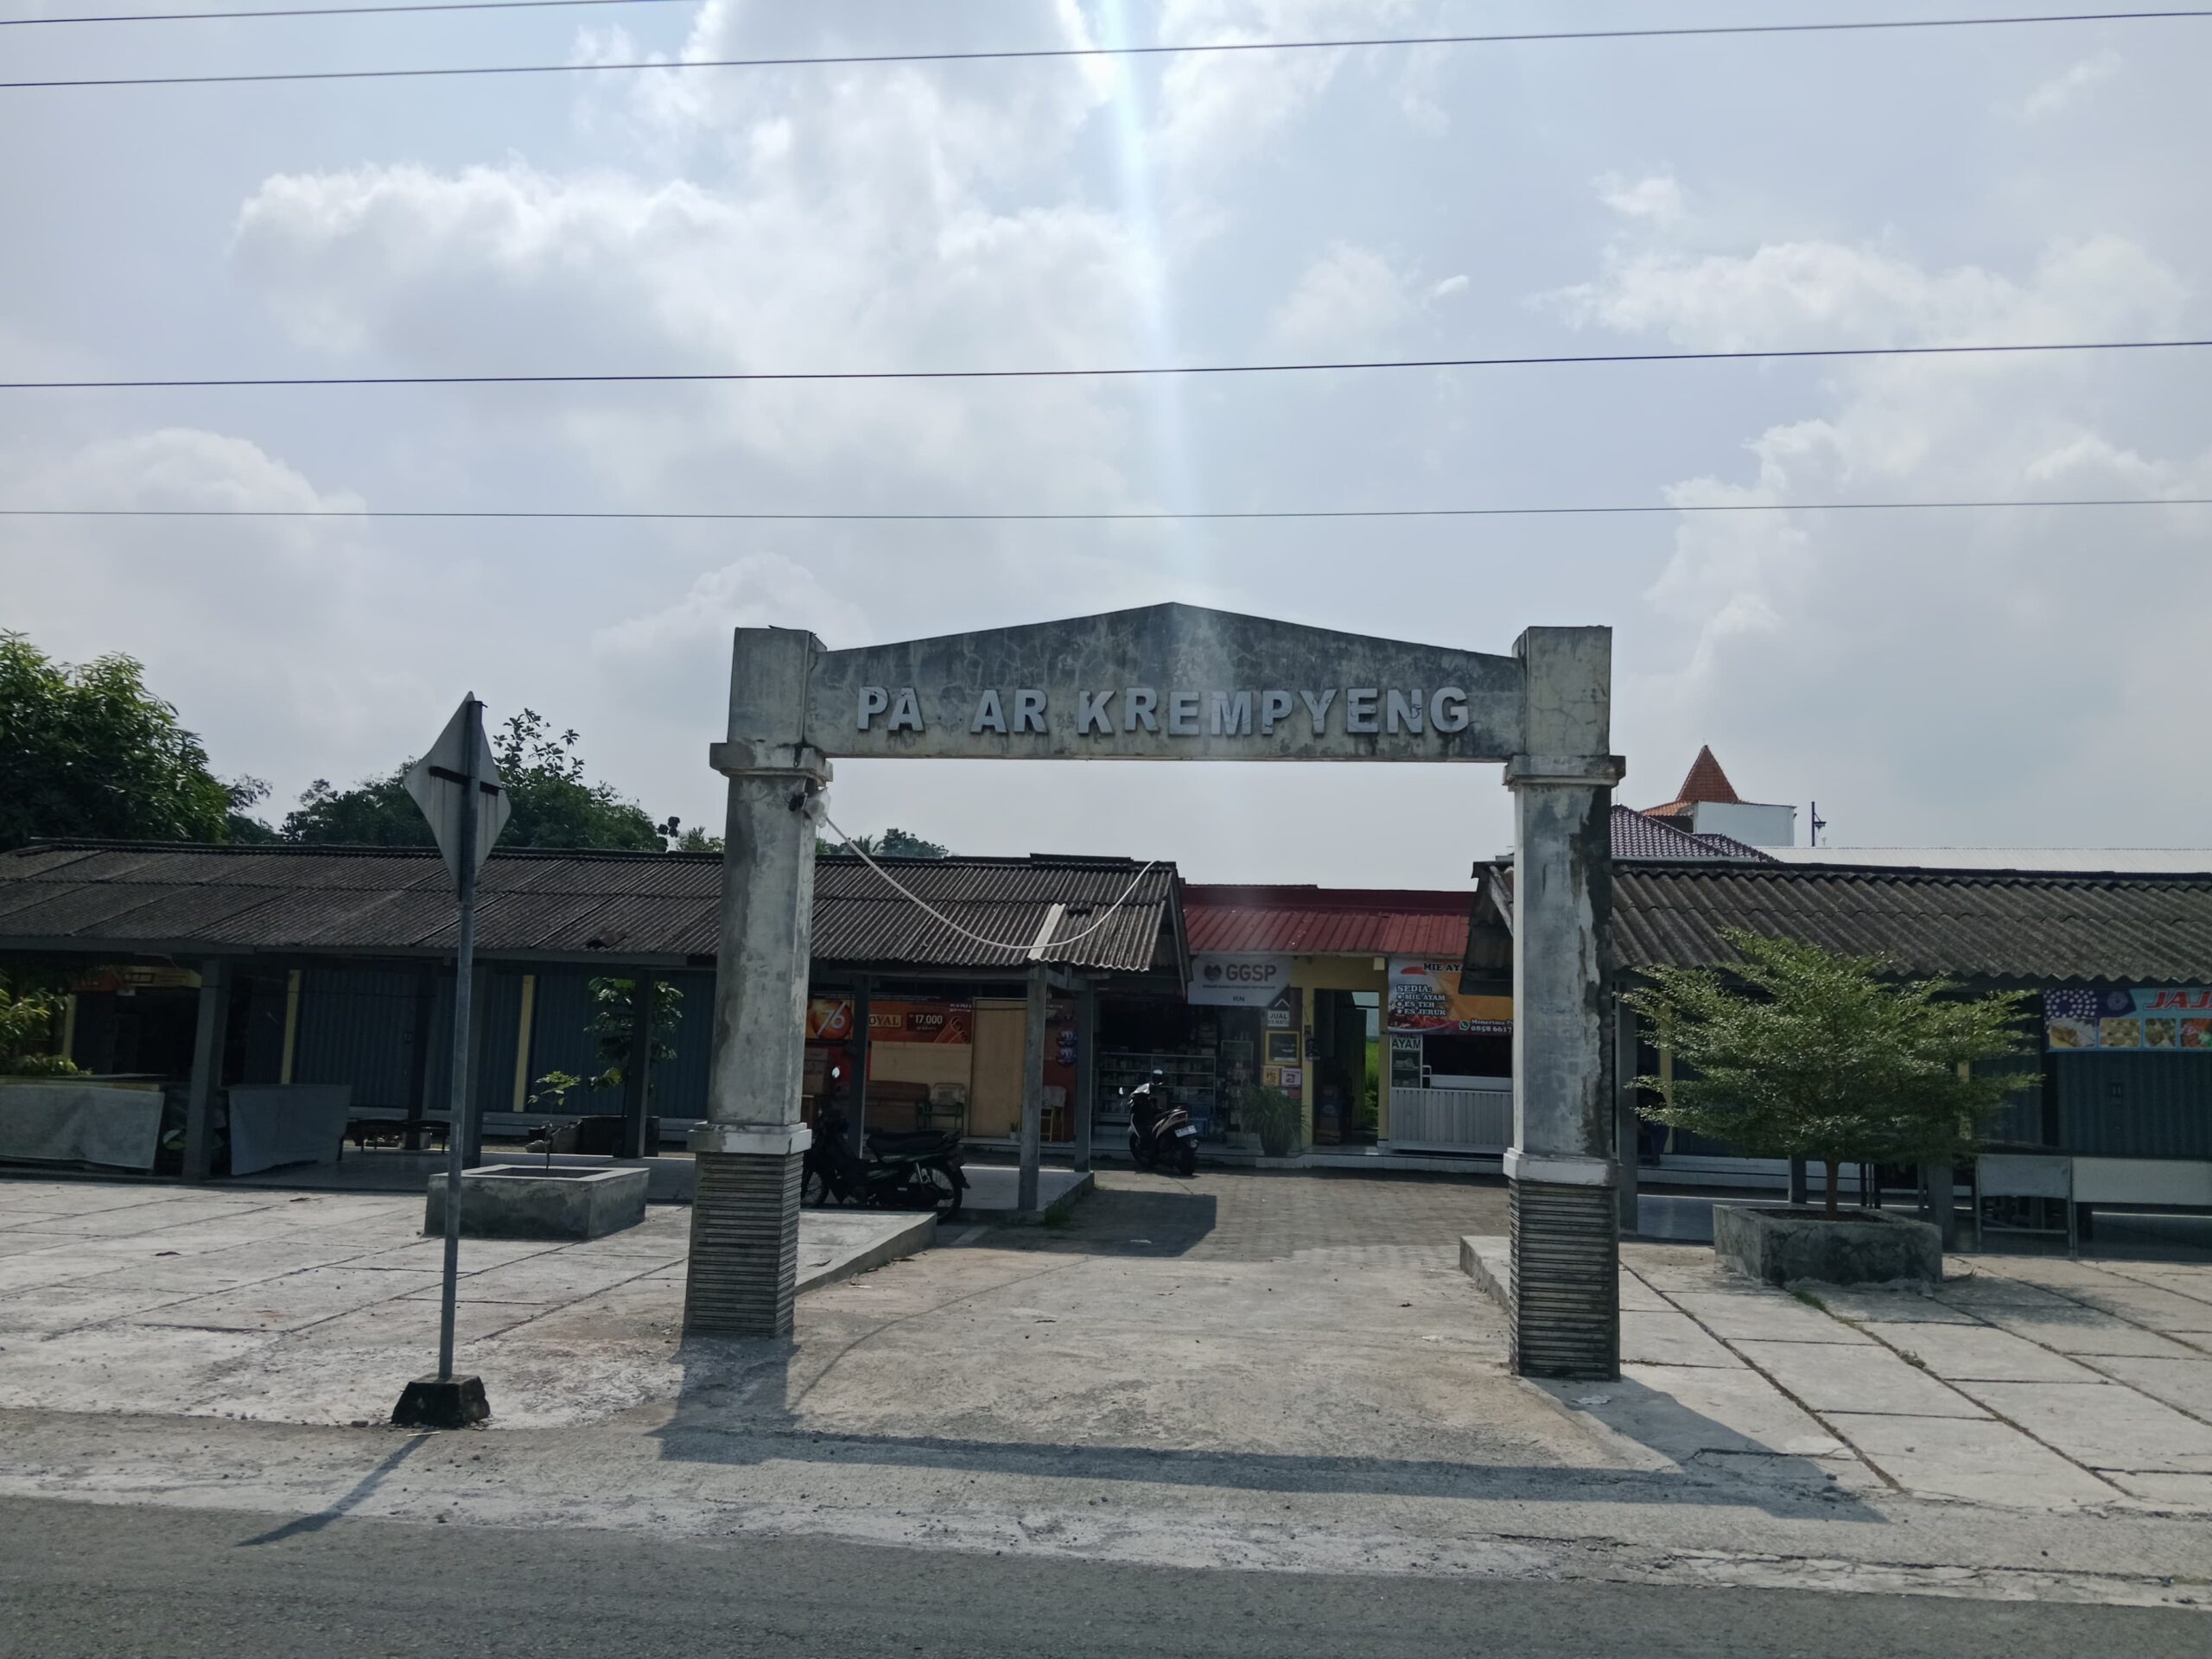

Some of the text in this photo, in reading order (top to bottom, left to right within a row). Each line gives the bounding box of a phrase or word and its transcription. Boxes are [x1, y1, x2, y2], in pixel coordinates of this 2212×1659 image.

[1077, 686, 1470, 736] KREMPYENG
[1225, 963, 1277, 982] GGSP
[1423, 963, 1464, 972] MIE AY
[1396, 984, 1433, 993] SEDIA:
[817, 1001, 847, 1038] 76
[867, 1014, 899, 1027] OYAL
[914, 1014, 944, 1025] 17.000
[1392, 1039, 1421, 1050] AYAM
